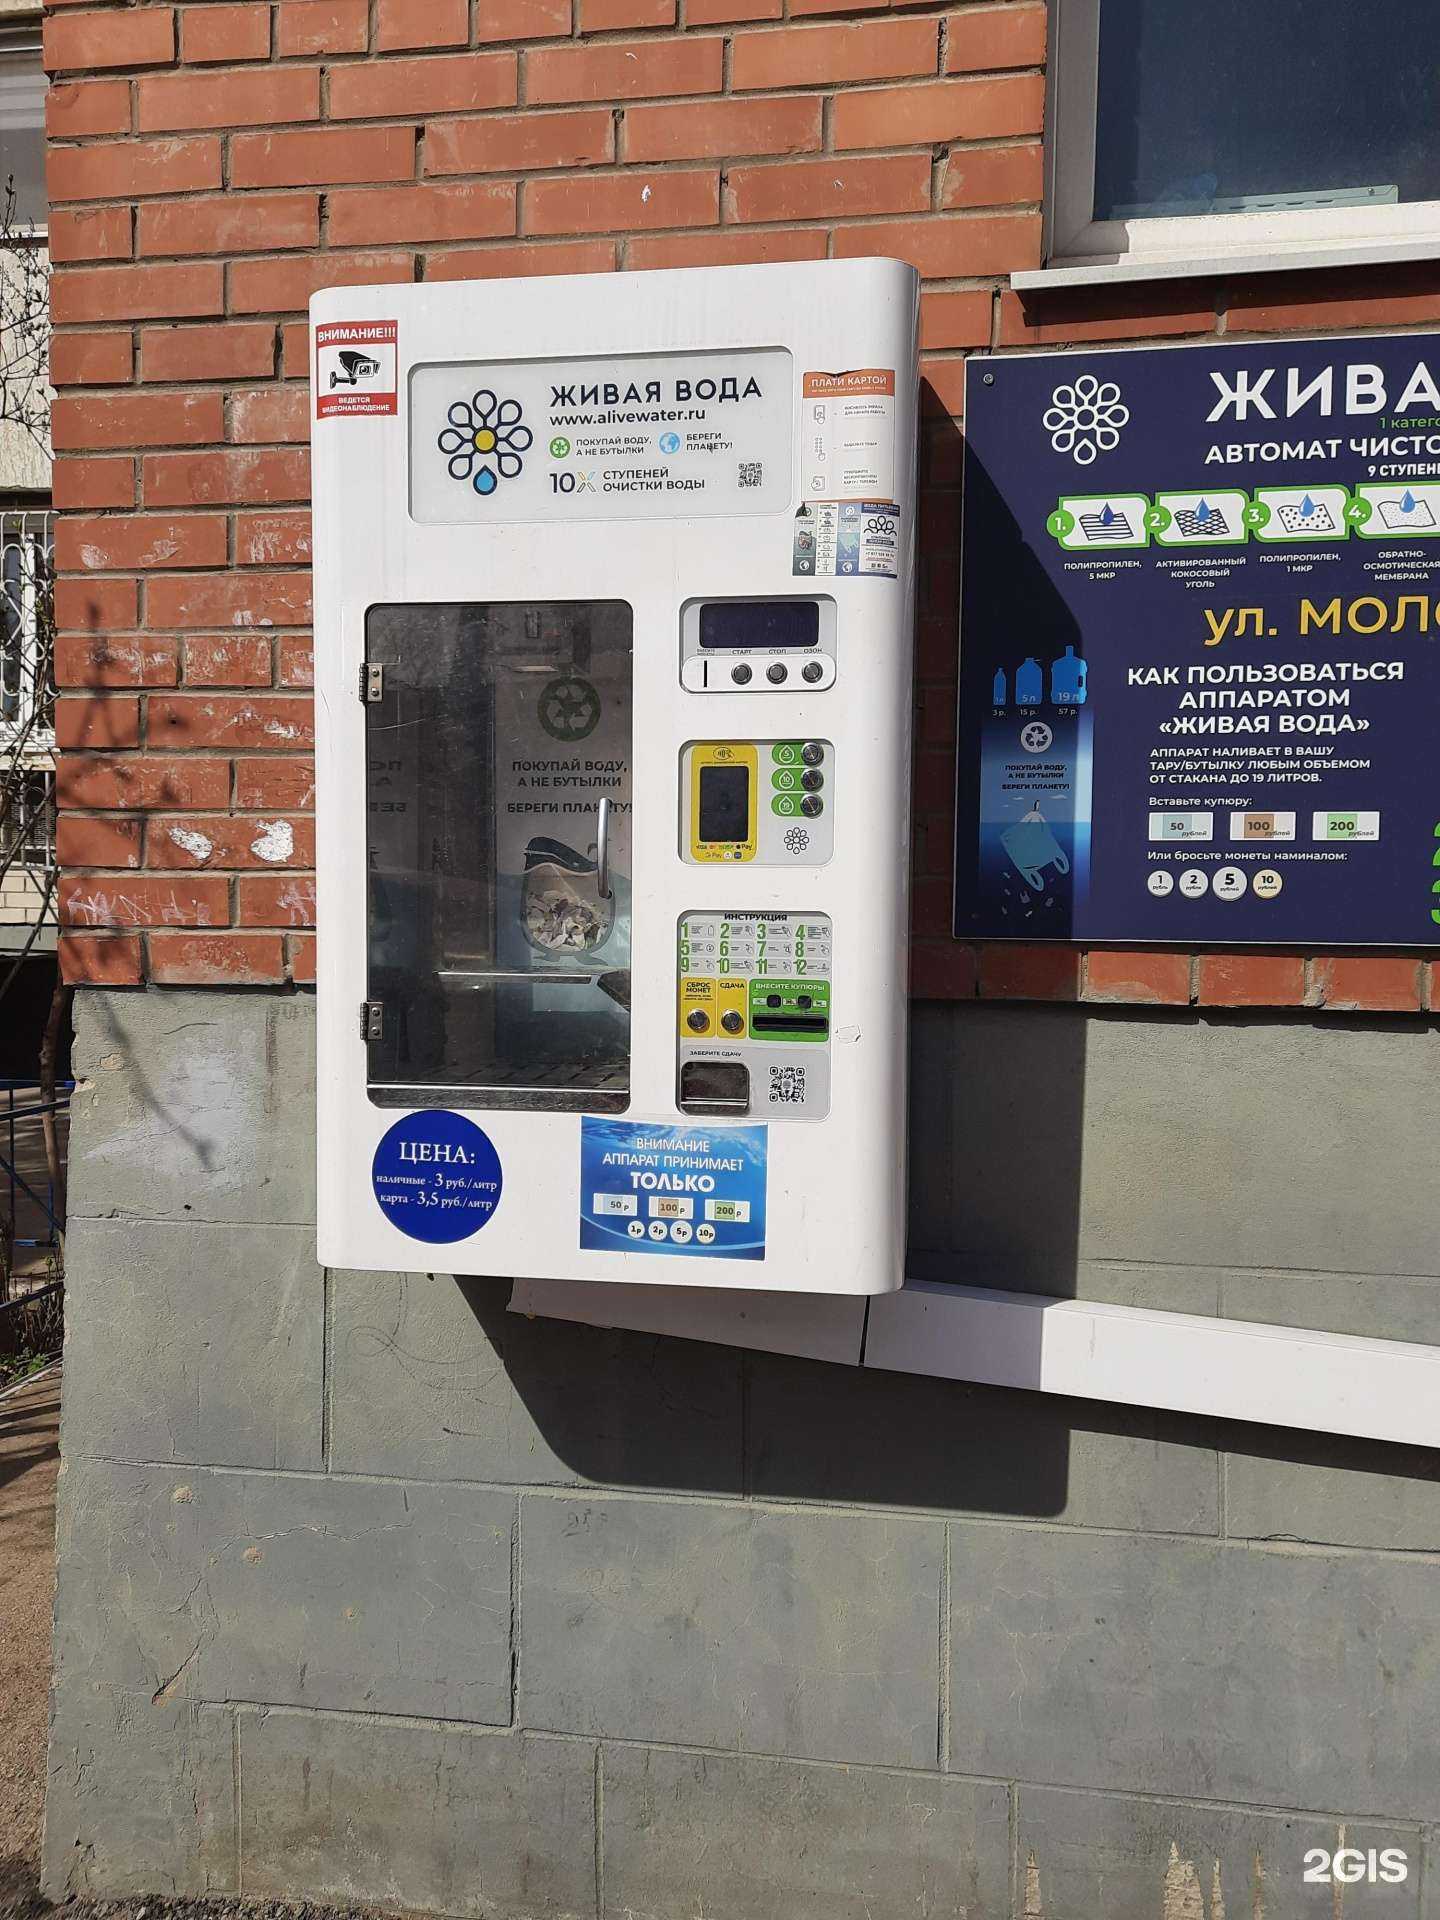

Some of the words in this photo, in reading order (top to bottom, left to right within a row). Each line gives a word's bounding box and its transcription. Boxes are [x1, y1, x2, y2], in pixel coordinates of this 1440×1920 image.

[318, 327, 396, 342] ВНИМАНИЕ!!!
[811, 378, 844, 387] ПЛАТИ
[847, 375, 887, 385] КАРТОЙ
[550, 381, 661, 407] ЖИВАЯ
[675, 376, 762, 403] ВОДА
[550, 409, 706, 426] www.alivewater.ru
[1379, 417, 1386, 429] 1
[576, 437, 621, 446] ПОКУПАЙ
[624, 436, 652, 446] ВОДУ,
[686, 432, 722, 441] БЕРЕГИ
[576, 448, 583, 456] А
[585, 448, 598, 456] НЕ
[600, 447, 644, 456] БУТЫЛКИ
[686, 442, 733, 451] ПЛАНЕТУ!
[1204, 439, 1342, 465] АВТОМАТ
[603, 467, 669, 480] СТУПЕНЕЙ
[1367, 465, 1375, 477] 9
[603, 481, 664, 492] ОЧИСТКИ
[666, 479, 705, 491] ВОДЫ
[1259, 553, 1341, 563] ПОЛИПРОПИЛЕН,
[1378, 550, 1427, 559] ОБРАТНО-
[1064, 560, 1142, 570] ПОЛИПРОПИЛЕН,
[1156, 557, 1246, 568] АКТИВИРОВАННЫЙ
[1363, 560, 1440, 570] ОСМОТИЧЕСКАЯ
[1171, 568, 1230, 579] КОКОСОВЫЙ
[1286, 565, 1291, 573] 1
[1293, 565, 1313, 573] МКР
[1089, 572, 1095, 580] 5
[1096, 572, 1116, 580] МКР
[1374, 572, 1429, 581] МЕМБРАНА
[1185, 580, 1215, 589] УГОЛЬ
[1203, 607, 1278, 647] ул.
[1300, 595, 1440, 635] МОЛ
[1128, 667, 1180, 686] КАК
[1187, 661, 1405, 685] ПОЛЬЗОВАТЬСЯ
[1178, 688, 1350, 709] АППАРАТОМ
[1159, 715, 1270, 735] «ЖИВАЯ
[1278, 714, 1370, 736] ВОДА»
[1150, 748, 1210, 758] АППАРАТ
[1212, 747, 1281, 757] НАЛИВАЕТ
[1284, 747, 1293, 756] В
[1296, 746, 1335, 756] ВАШУ
[512, 758, 580, 772] ПОКУПАЙ
[585, 760, 628, 773] ВОДУ,
[1005, 763, 1043, 771] ПОКУПАЙ
[1044, 764, 1068, 772] ВОДУ,
[1150, 760, 1245, 772] ТАРУ/БУТЫЛКУ
[1248, 760, 1300, 770] ЛЮБЫМ
[1303, 759, 1371, 769] ОБЪЕМОМ
[518, 777, 528, 787] А
[531, 777, 550, 787] НЕ
[553, 776, 622, 787] БУТЫЛКИ
[1149, 774, 1166, 784] ОТ
[1168, 774, 1227, 784] СТАКАНА
[1230, 774, 1250, 785] ДО
[1252, 773, 1265, 783] 19
[1266, 773, 1323, 783] ЛИТРОВ.
[507, 802, 559, 813] БЕРЕГИ
[1149, 797, 1201, 806] Вставьте
[1204, 796, 1253, 808] купюру:
[1170, 822, 1185, 831] 50
[1247, 821, 1270, 832] 100
[1329, 821, 1355, 832] 200
[1147, 851, 1172, 861] Или
[1174, 850, 1222, 861] бросьте
[1225, 852, 1272, 861] монеты
[1274, 851, 1348, 861] наминалом:
[1157, 875, 1163, 884] 1
[1189, 874, 1198, 884] 2
[1224, 873, 1235, 886] 5
[1261, 875, 1274, 884] 10
[724, 913, 788, 922] ИНСТРУКЦИЯ
[681, 922, 688, 938] 1
[720, 923, 730, 938] 2
[757, 924, 766, 939] 3
[795, 925, 806, 940] 4
[681, 940, 689, 955] 5
[720, 941, 729, 956] 6
[757, 941, 767, 956] 7
[795, 942, 805, 957] 8
[681, 957, 689, 972] 9
[716, 958, 730, 973] 10
[756, 959, 768, 974] 11
[793, 960, 807, 975] 12
[636, 1138, 710, 1153] ВНИМАНИЕ
[399, 1142, 475, 1165] ЦЕНА:
[602, 1153, 660, 1168] АППАРАТ
[664, 1155, 744, 1172] ПРИНИМАЕТ
[376, 1175, 426, 1185] наличные
[434, 1173, 443, 1187] 3
[446, 1178, 498, 1193] руб./литр
[630, 1171, 716, 1193] ТОЛЬКО
[380, 1194, 408, 1205] карта
[417, 1191, 439, 1207] 3,5
[441, 1197, 492, 1212] руб./литр
[610, 1200, 622, 1209] 50
[660, 1203, 678, 1212] 100
[716, 1206, 734, 1215] 200
